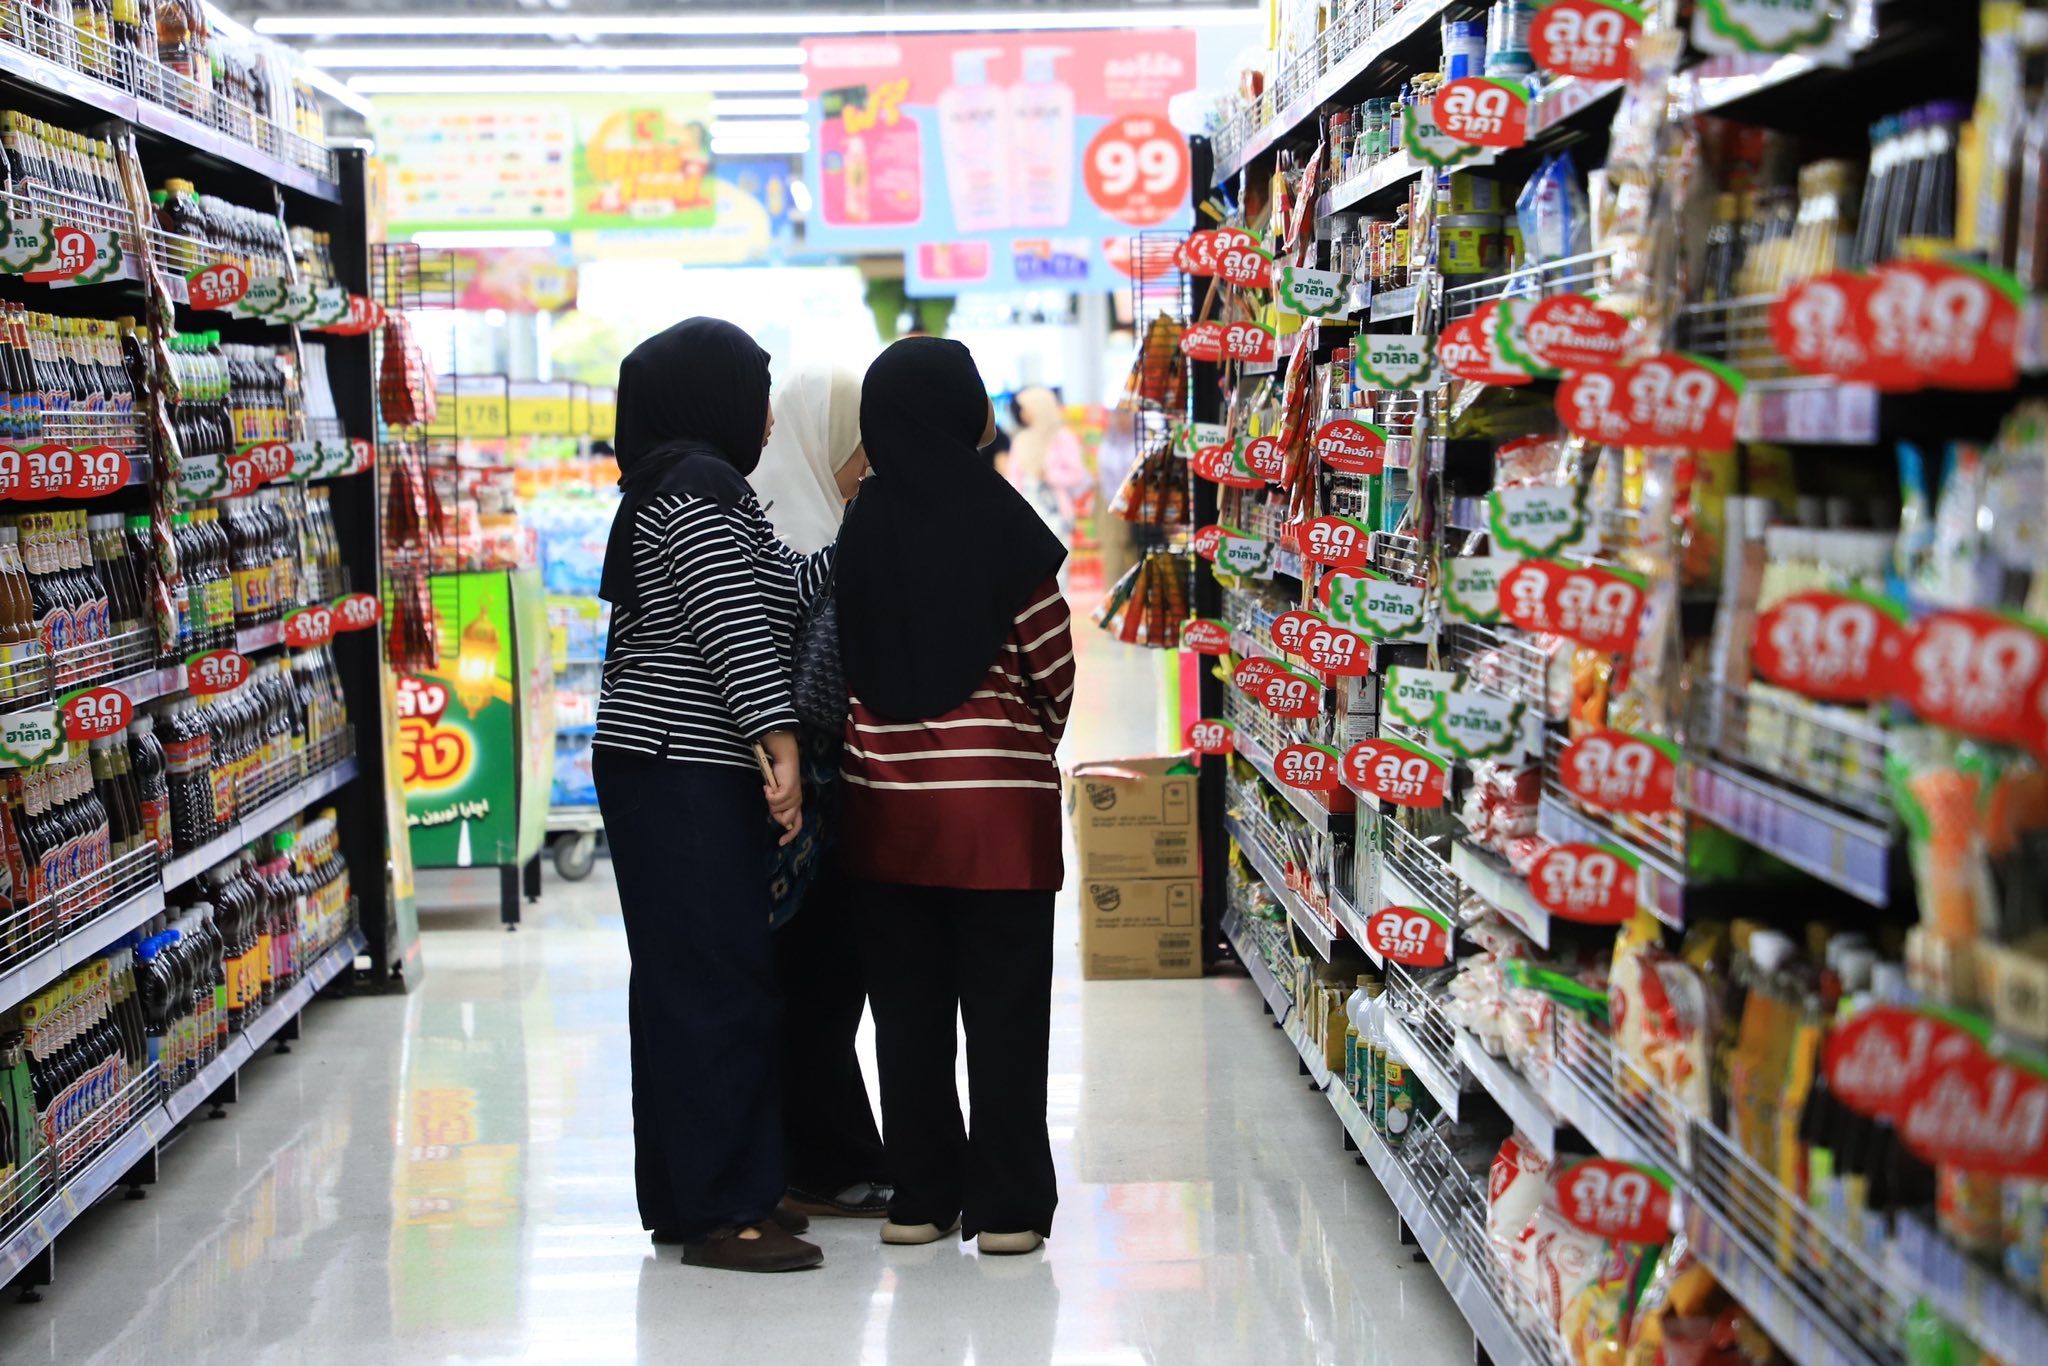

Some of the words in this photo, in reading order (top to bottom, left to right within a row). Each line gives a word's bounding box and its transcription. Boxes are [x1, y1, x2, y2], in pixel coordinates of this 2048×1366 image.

[1544, 8, 1624, 45] ลด
[1444, 85, 1510, 117] ลด
[1447, 115, 1502, 134] ราคา
[1095, 138, 1181, 195] 99
[55, 233, 86, 257] ด
[1223, 250, 1261, 271] ลด
[200, 267, 240, 290] ลด
[1225, 267, 1256, 280] ราคา
[1293, 283, 1334, 298] ฮาลาล
[1227, 326, 1264, 346] ลด
[1372, 352, 1419, 364] ฮาลาล
[1573, 372, 1615, 409] ล
[1629, 361, 1718, 409] ลด
[0, 451, 20, 475] ด
[252, 445, 288, 464] ลด
[1254, 459, 1281, 470] ราค
[231, 460, 252, 479] ด
[30, 473, 72, 488] ราคา
[1309, 522, 1356, 545] ลด
[1228, 550, 1261, 561] ฮาลาล
[1311, 543, 1351, 558] ราคา
[1457, 578, 1496, 592] ฮาลา
[1511, 567, 1549, 600] ล
[1557, 575, 1637, 615] ลด
[1368, 599, 1415, 615] ฮาลาล
[1309, 630, 1356, 654] ลด
[200, 654, 241, 676] ลด
[1311, 652, 1351, 666] ราคา
[1266, 678, 1308, 698] ลด
[75, 693, 122, 718] ลด
[1268, 696, 1303, 711] ราคา
[81, 714, 121, 730] ราคา
[1191, 724, 1225, 739] ลด
[6, 728, 52, 743] ฮาลาล
[1282, 750, 1325, 771] ลด
[1573, 737, 1655, 777] ลด
[1285, 768, 1321, 782] ราคา
[1374, 754, 1430, 783] ลด
[1377, 778, 1424, 796] ราคา
[1541, 848, 1617, 886] ลด
[1376, 913, 1431, 942] ลด
[1378, 938, 1425, 955] ราคา
[1571, 1167, 1650, 1207] ลด
